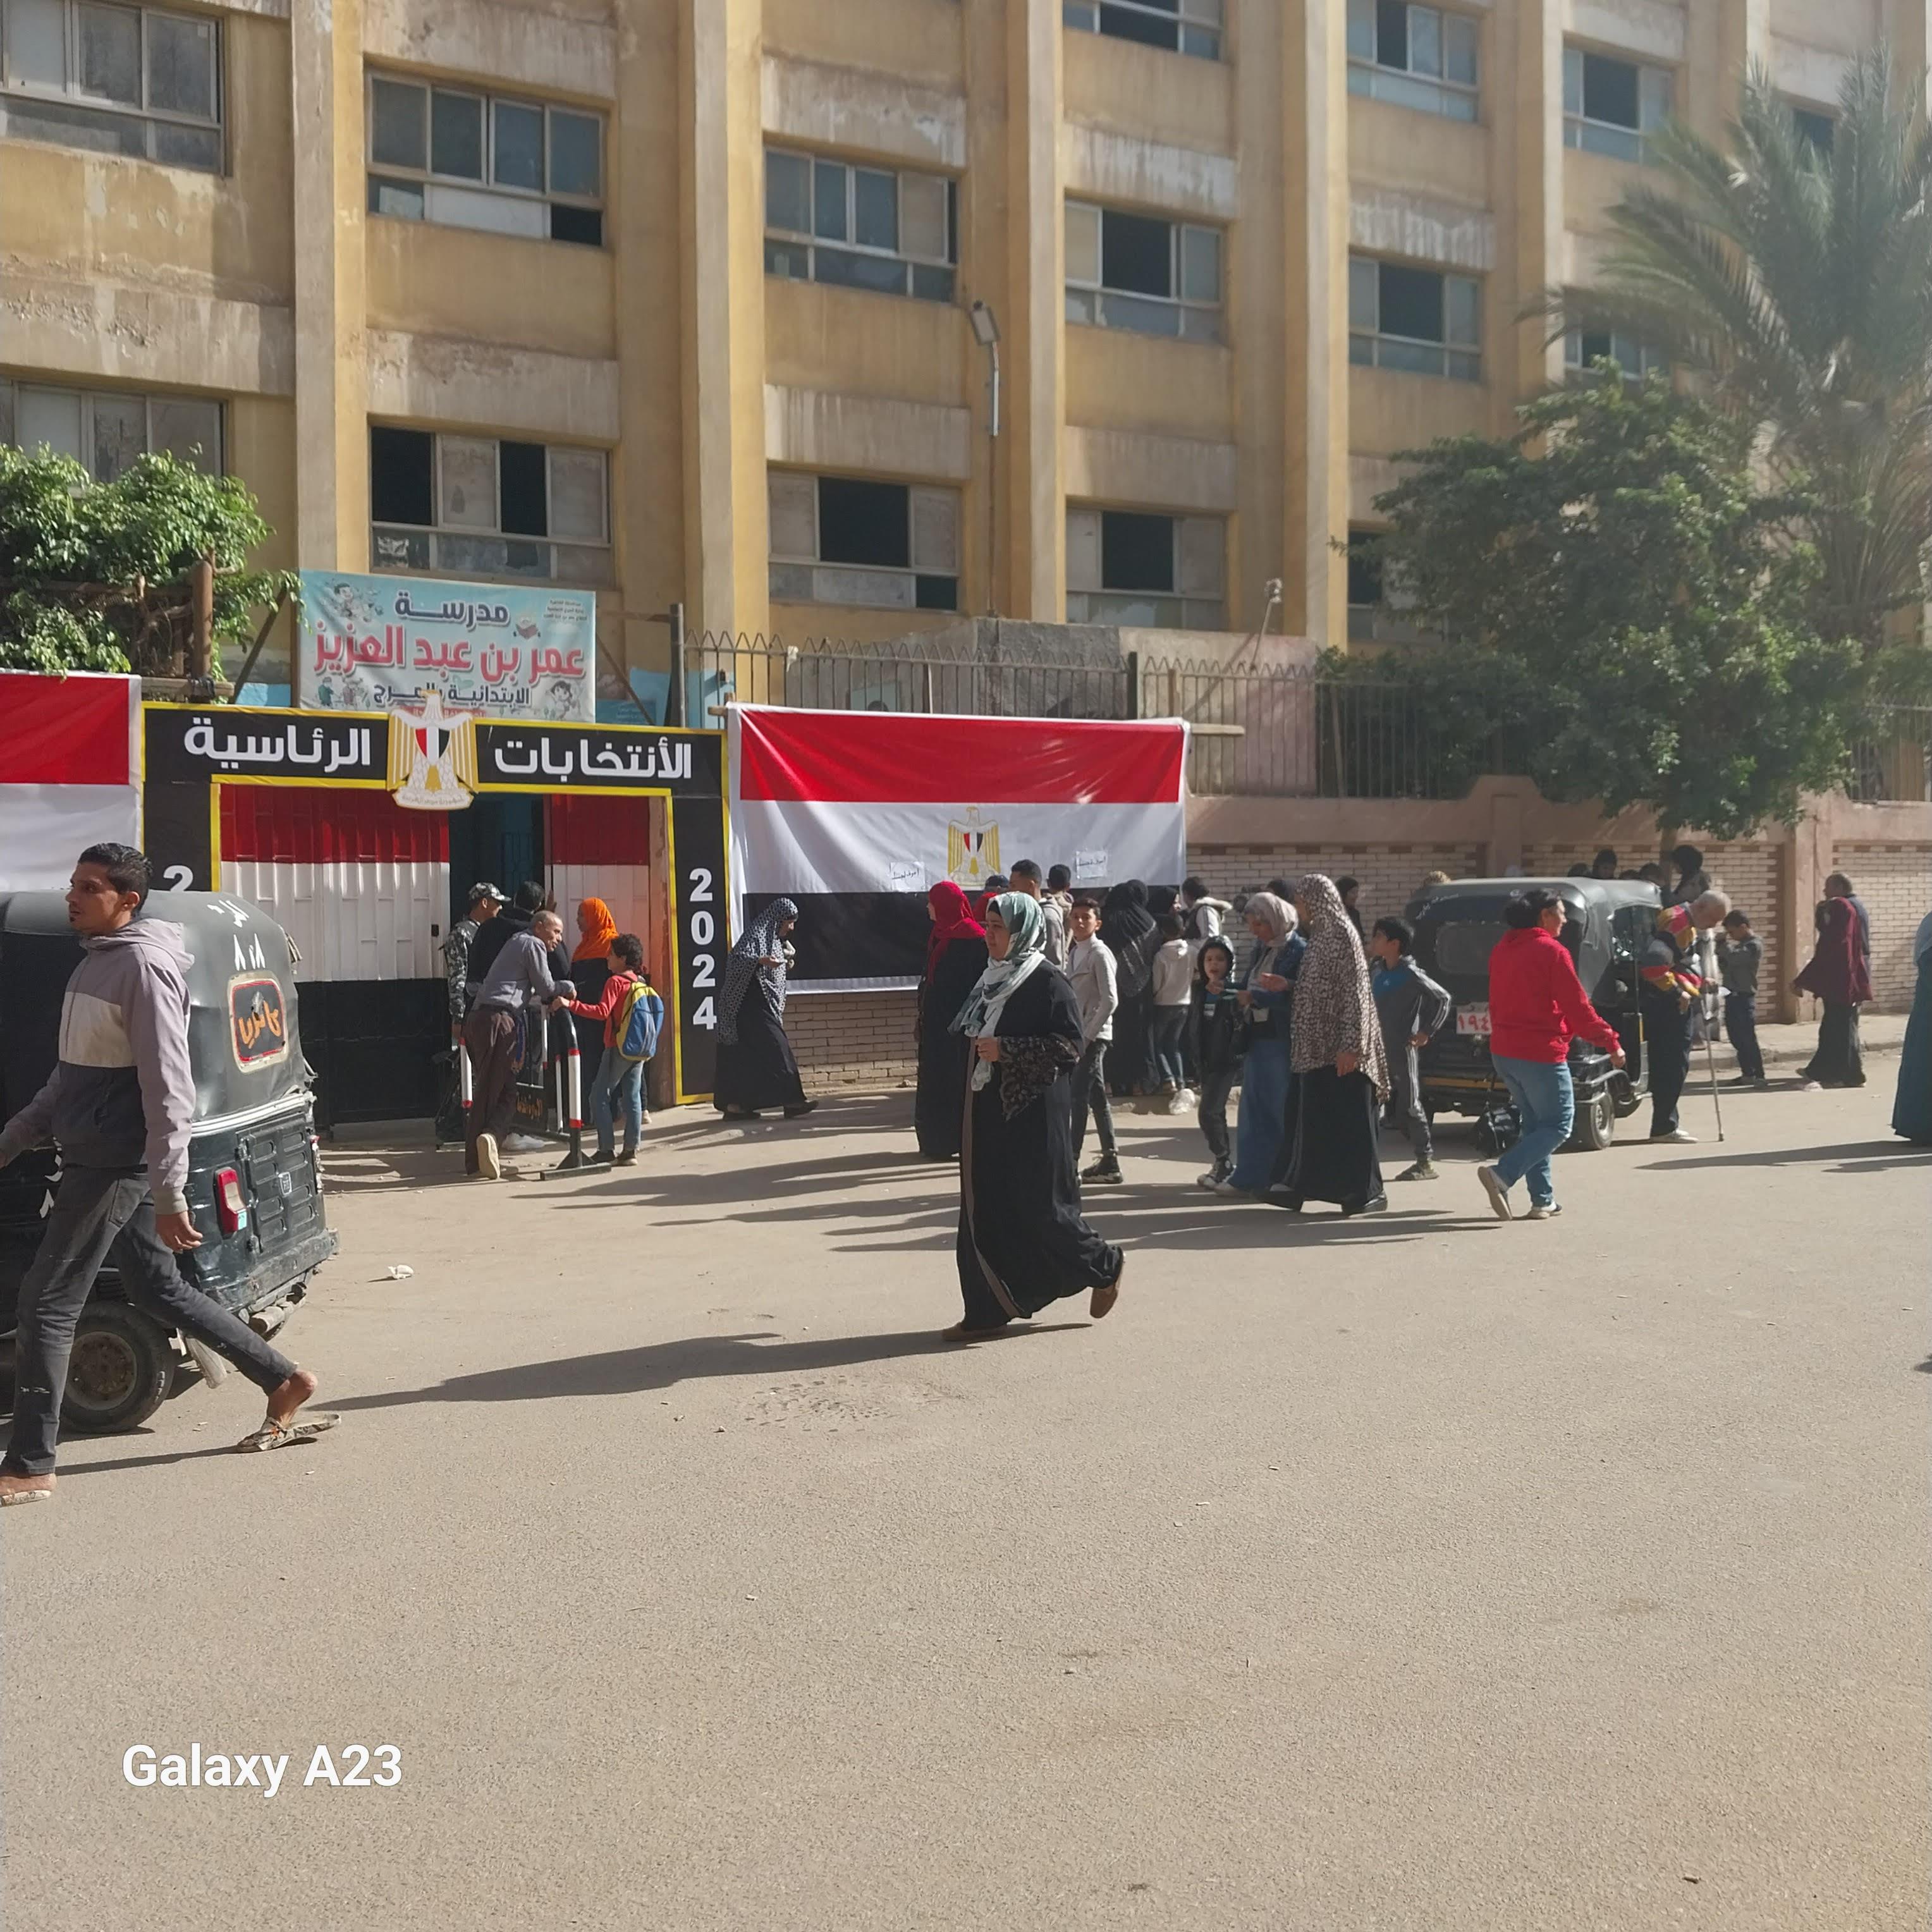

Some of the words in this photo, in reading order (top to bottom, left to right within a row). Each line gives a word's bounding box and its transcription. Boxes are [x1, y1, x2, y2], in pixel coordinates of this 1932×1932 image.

[395, 592, 508, 628] مدرسة
[314, 622, 403, 674] العزيز
[413, 638, 470, 679] عبد
[480, 644, 519, 682] بن
[530, 647, 584, 683] عمر
[184, 717, 371, 772] الرئاسية
[495, 737, 691, 783] الأنتخابات
[689, 868, 717, 1030] 2024
